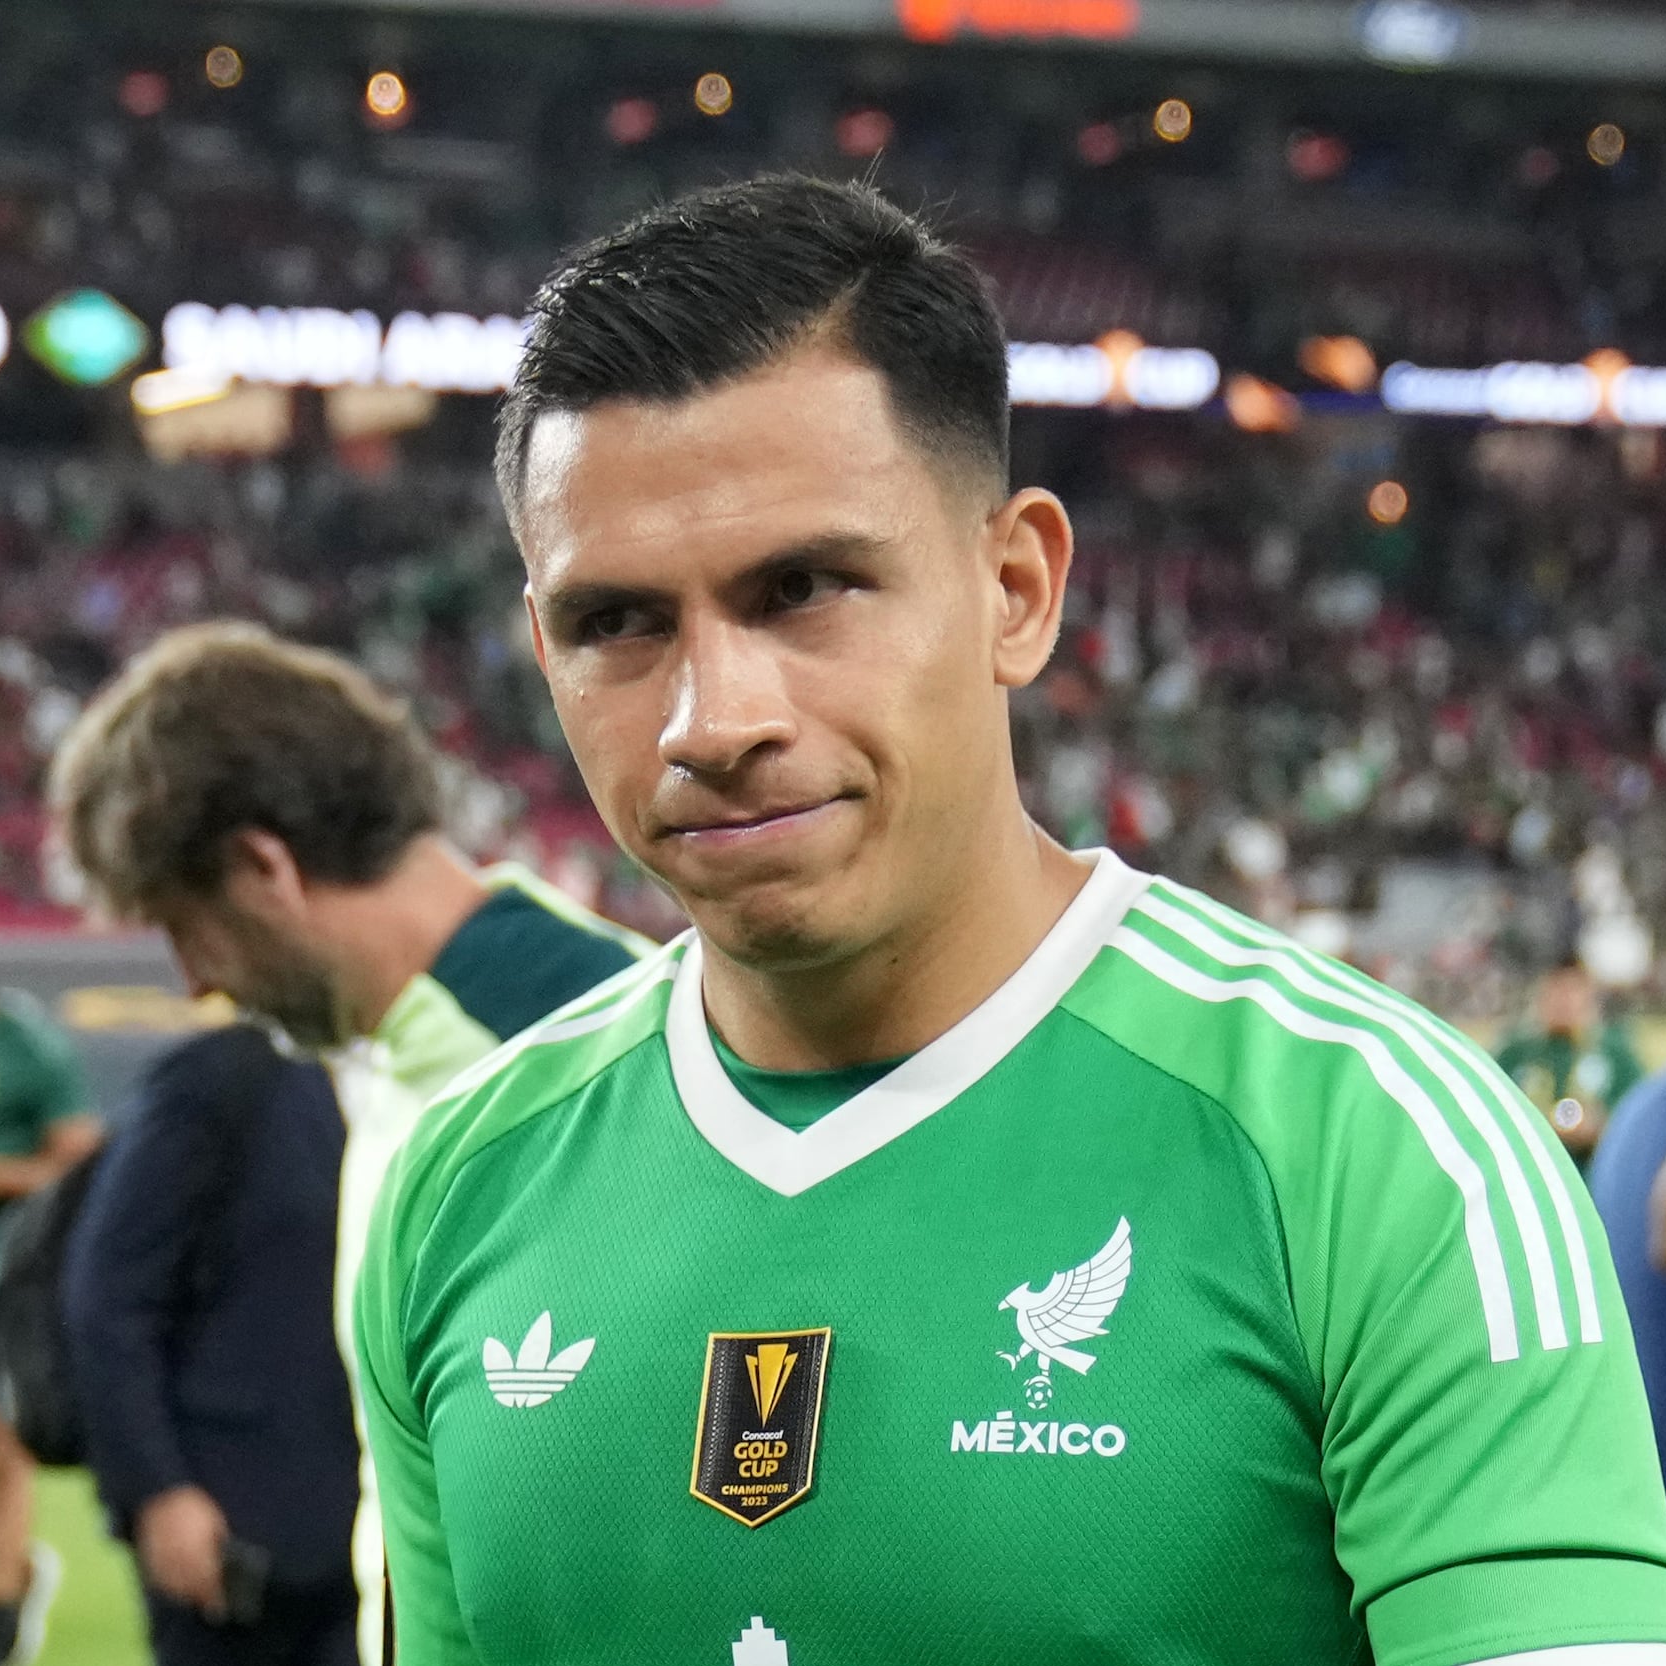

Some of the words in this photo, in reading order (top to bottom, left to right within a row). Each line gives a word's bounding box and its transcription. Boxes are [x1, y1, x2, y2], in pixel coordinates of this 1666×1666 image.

[741, 1430, 784, 1441] Concacaf
[950, 1410, 1126, 1457] MÉXICO
[733, 1441, 789, 1460] GOLD
[738, 1459, 779, 1478] CUP
[721, 1483, 789, 1495] CHAMPIONS
[741, 1496, 768, 1507] 2023
